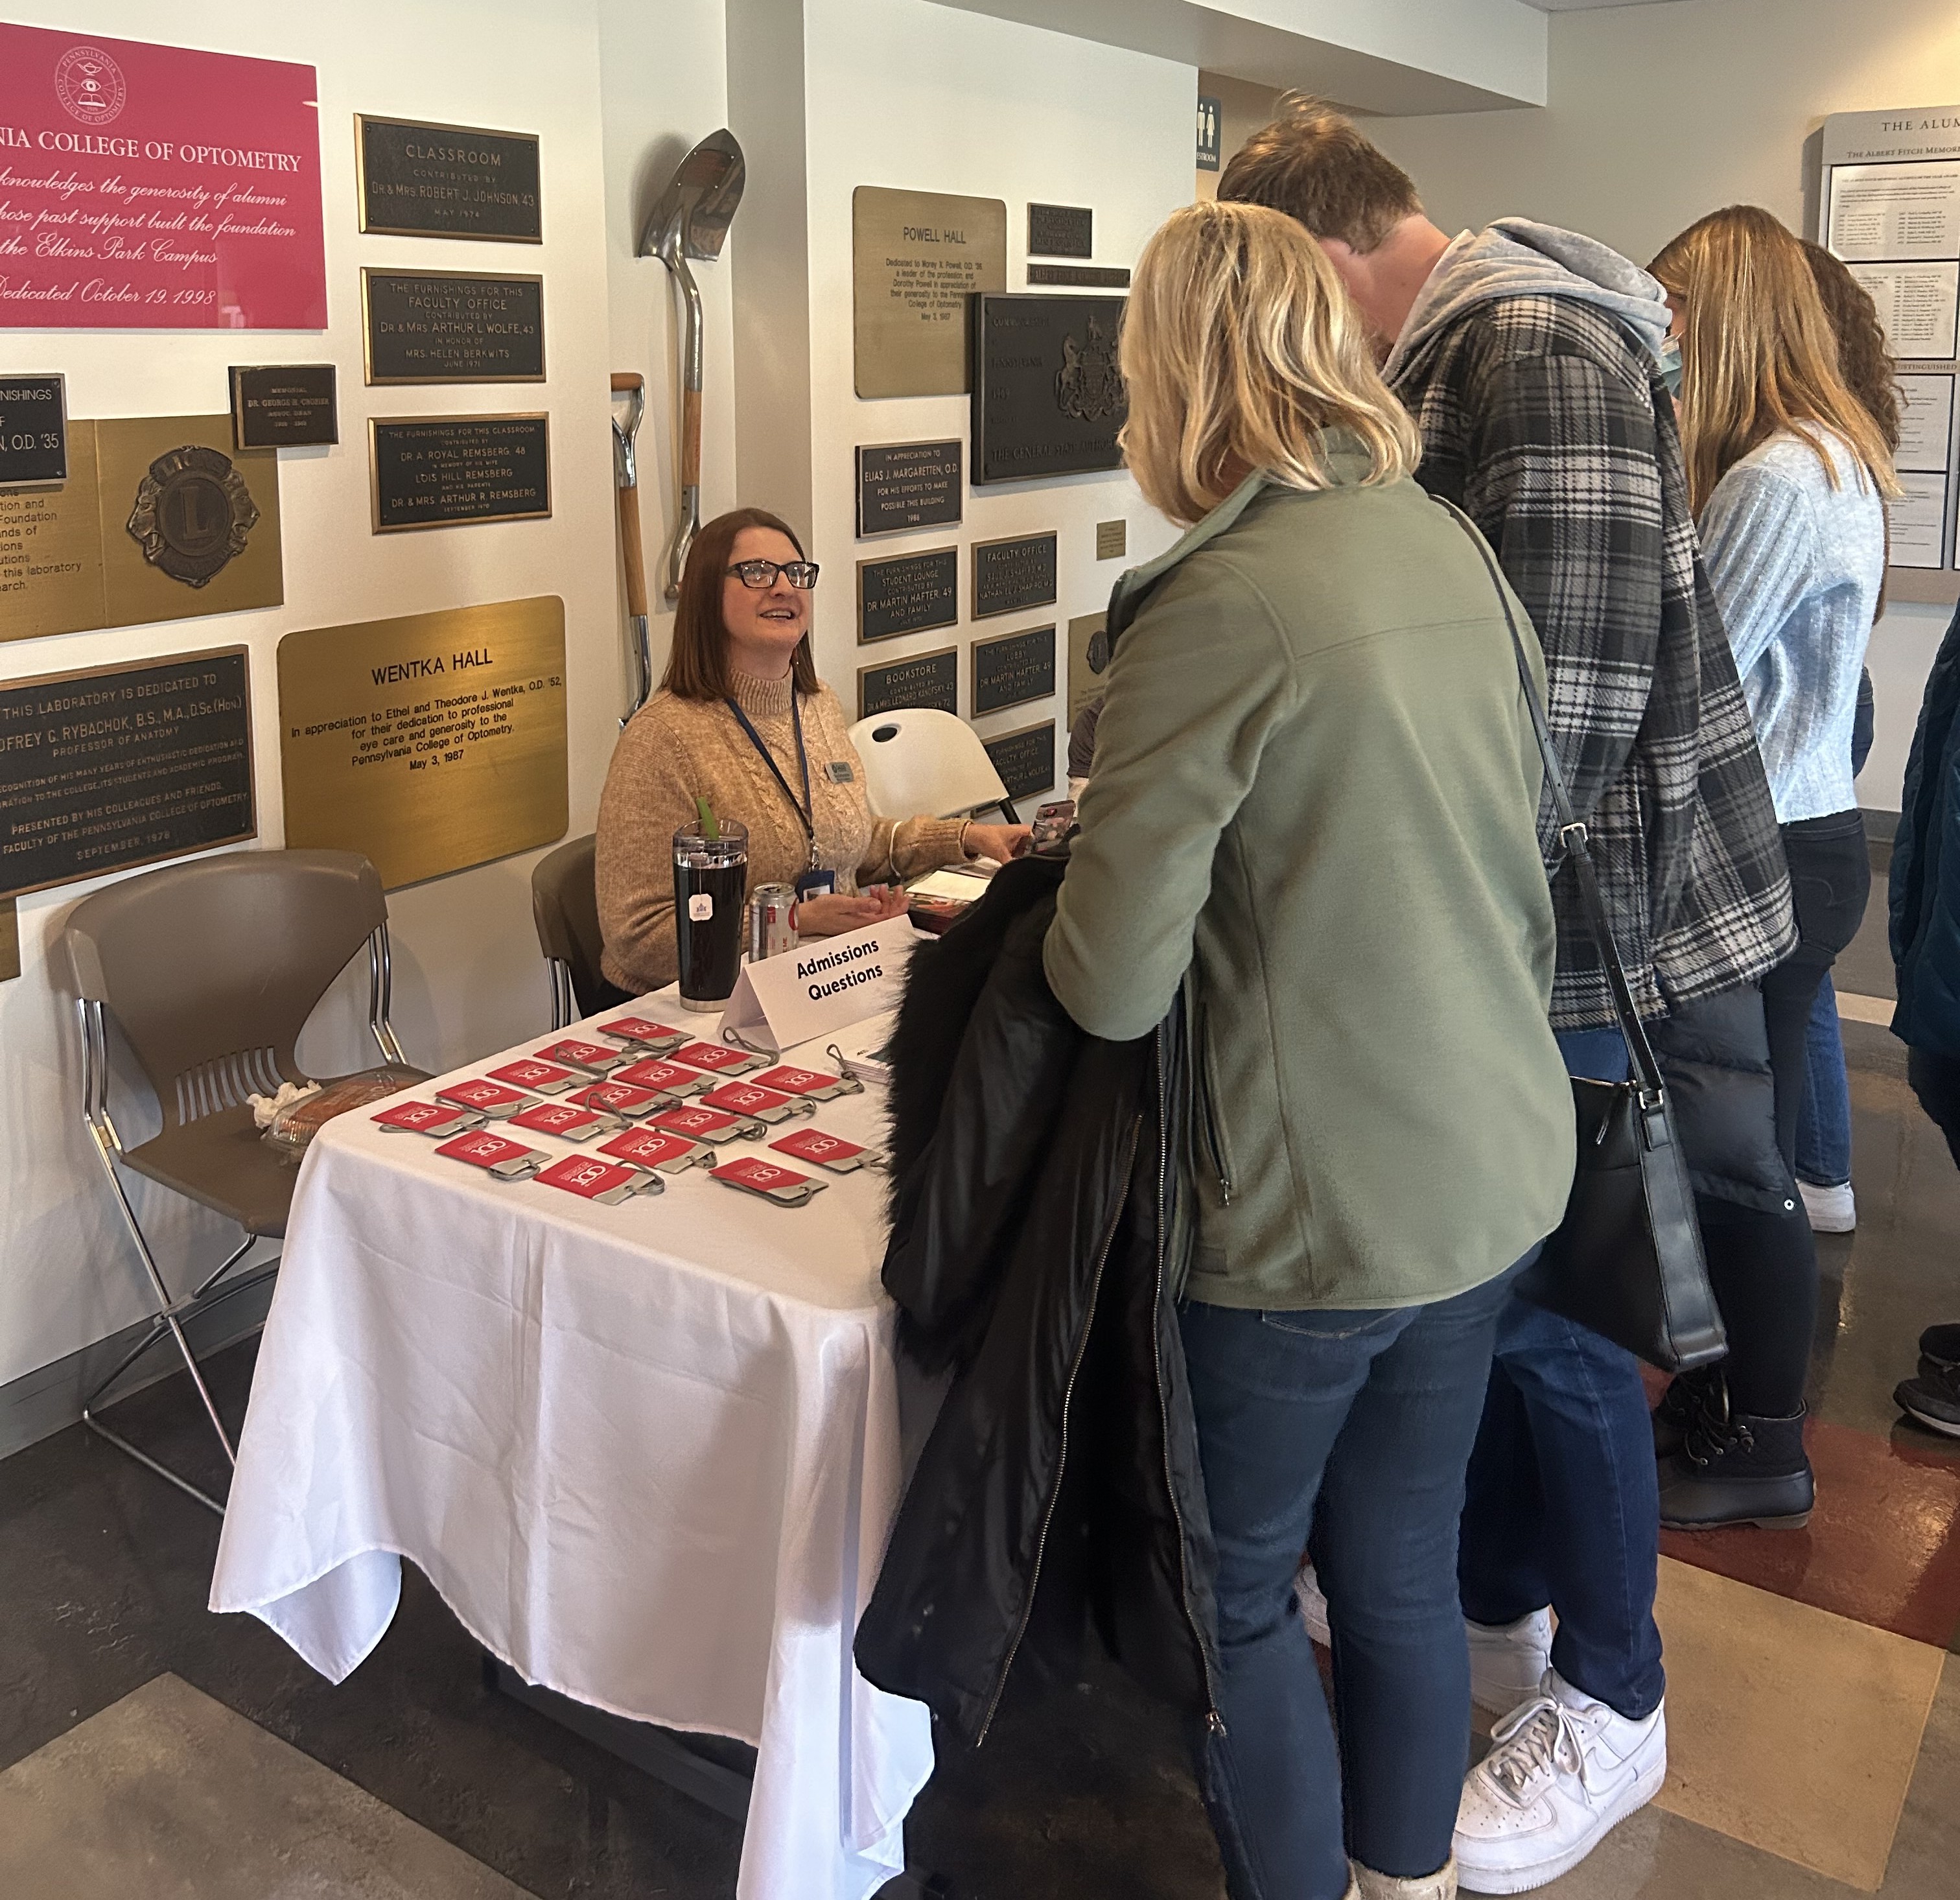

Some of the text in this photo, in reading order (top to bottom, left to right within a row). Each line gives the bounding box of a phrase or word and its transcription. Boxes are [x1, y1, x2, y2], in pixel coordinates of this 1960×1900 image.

[1882, 121, 1913, 131] THE
[38, 130, 301, 172] COLLEGE OF OPTOMETRY
[406, 145, 501, 167] CLASSROOM
[413, 169, 479, 182] CONTRIBUTED
[100, 175, 128, 194] the
[124, 180, 210, 209] generosity
[213, 183, 230, 208] of
[232, 186, 287, 206] alumni
[420, 185, 459, 199] ROBERT
[29, 207, 76, 231] past
[80, 212, 145, 235] support
[148, 211, 186, 230] built
[189, 213, 213, 232] the
[212, 214, 296, 239] foundation
[903, 227, 966, 244] POWELL HALL
[0, 232, 218, 270] the Elkins Park Campus
[81, 278, 139, 302] October
[172, 290, 215, 305] 1998
[390, 283, 522, 296] THE FURNISHINGS FOR THIS
[408, 297, 507, 311] FACULTY OFFICE
[432, 323, 473, 334] ARTHUR
[406, 428, 454, 438] FURNISHINGS
[12, 434, 59, 450] O.D. '35
[428, 450, 459, 460] ROYAL
[893, 451, 931, 460] APPRECIATION
[415, 469, 513, 484] LOIS HILL REMSBERG
[865, 471, 883, 482] ELIAS
[440, 488, 537, 504] ARTHUR REMSBERG
[901, 484, 923, 493] EFFORTS
[25, 498, 44, 508] and
[881, 500, 905, 511] POSSIBLE
[26, 526, 37, 535] of
[986, 545, 1047, 563] FACULTY OFFICE
[4, 563, 81, 578] this laboratory
[882, 570, 939, 587] STUDENT LOUNGE
[880, 596, 907, 609] MARTIN
[891, 604, 931, 618] AND FAMILY
[371, 648, 493, 685] WENTKA HALL
[886, 664, 937, 685] BOOKSTORE
[990, 672, 1014, 684] MARTIN
[3, 674, 216, 720] THIS LABORATORY IS DEDICATED TO
[292, 727, 299, 738] In
[305, 716, 367, 736] appreciation
[371, 712, 382, 722] to
[386, 706, 410, 720] Ethel
[414, 701, 430, 714] and
[435, 694, 478, 710] Theodore
[482, 690, 489, 700] J.
[493, 685, 525, 698] Wentka,
[352, 698, 514, 739] for their dedication to professional
[360, 712, 507, 752] eye care and generosity to the
[52, 726, 180, 758] PROFESSOR OF ANATOMY
[352, 724, 515, 766] Pennsylvania College of Optometry.
[410, 749, 464, 770] May 3, 1987
[76, 768, 97, 777] MANY
[100, 762, 124, 773] YEARS
[12, 790, 182, 835] PRESENTED BY HIS AND
[3, 815, 146, 854] FACULTY OF THE PENNSYLVANIA
[797, 940, 879, 979] Admissions
[808, 964, 883, 1000] Questions
[629, 1023, 659, 1034] 100
[697, 1049, 728, 1063] 100
[519, 1067, 550, 1080] 100
[644, 1067, 675, 1083] 100
[784, 1072, 815, 1086] 100
[465, 1088, 500, 1102] 100
[732, 1090, 765, 1107] 100
[403, 1108, 439, 1123] 100
[543, 1109, 578, 1125] 100
[679, 1112, 713, 1127] 100
[470, 1140, 507, 1156] 100
[631, 1138, 666, 1156] 100
[804, 1139, 838, 1154] 100
[570, 1165, 607, 1186] 100
[746, 1167, 781, 1183] 100
